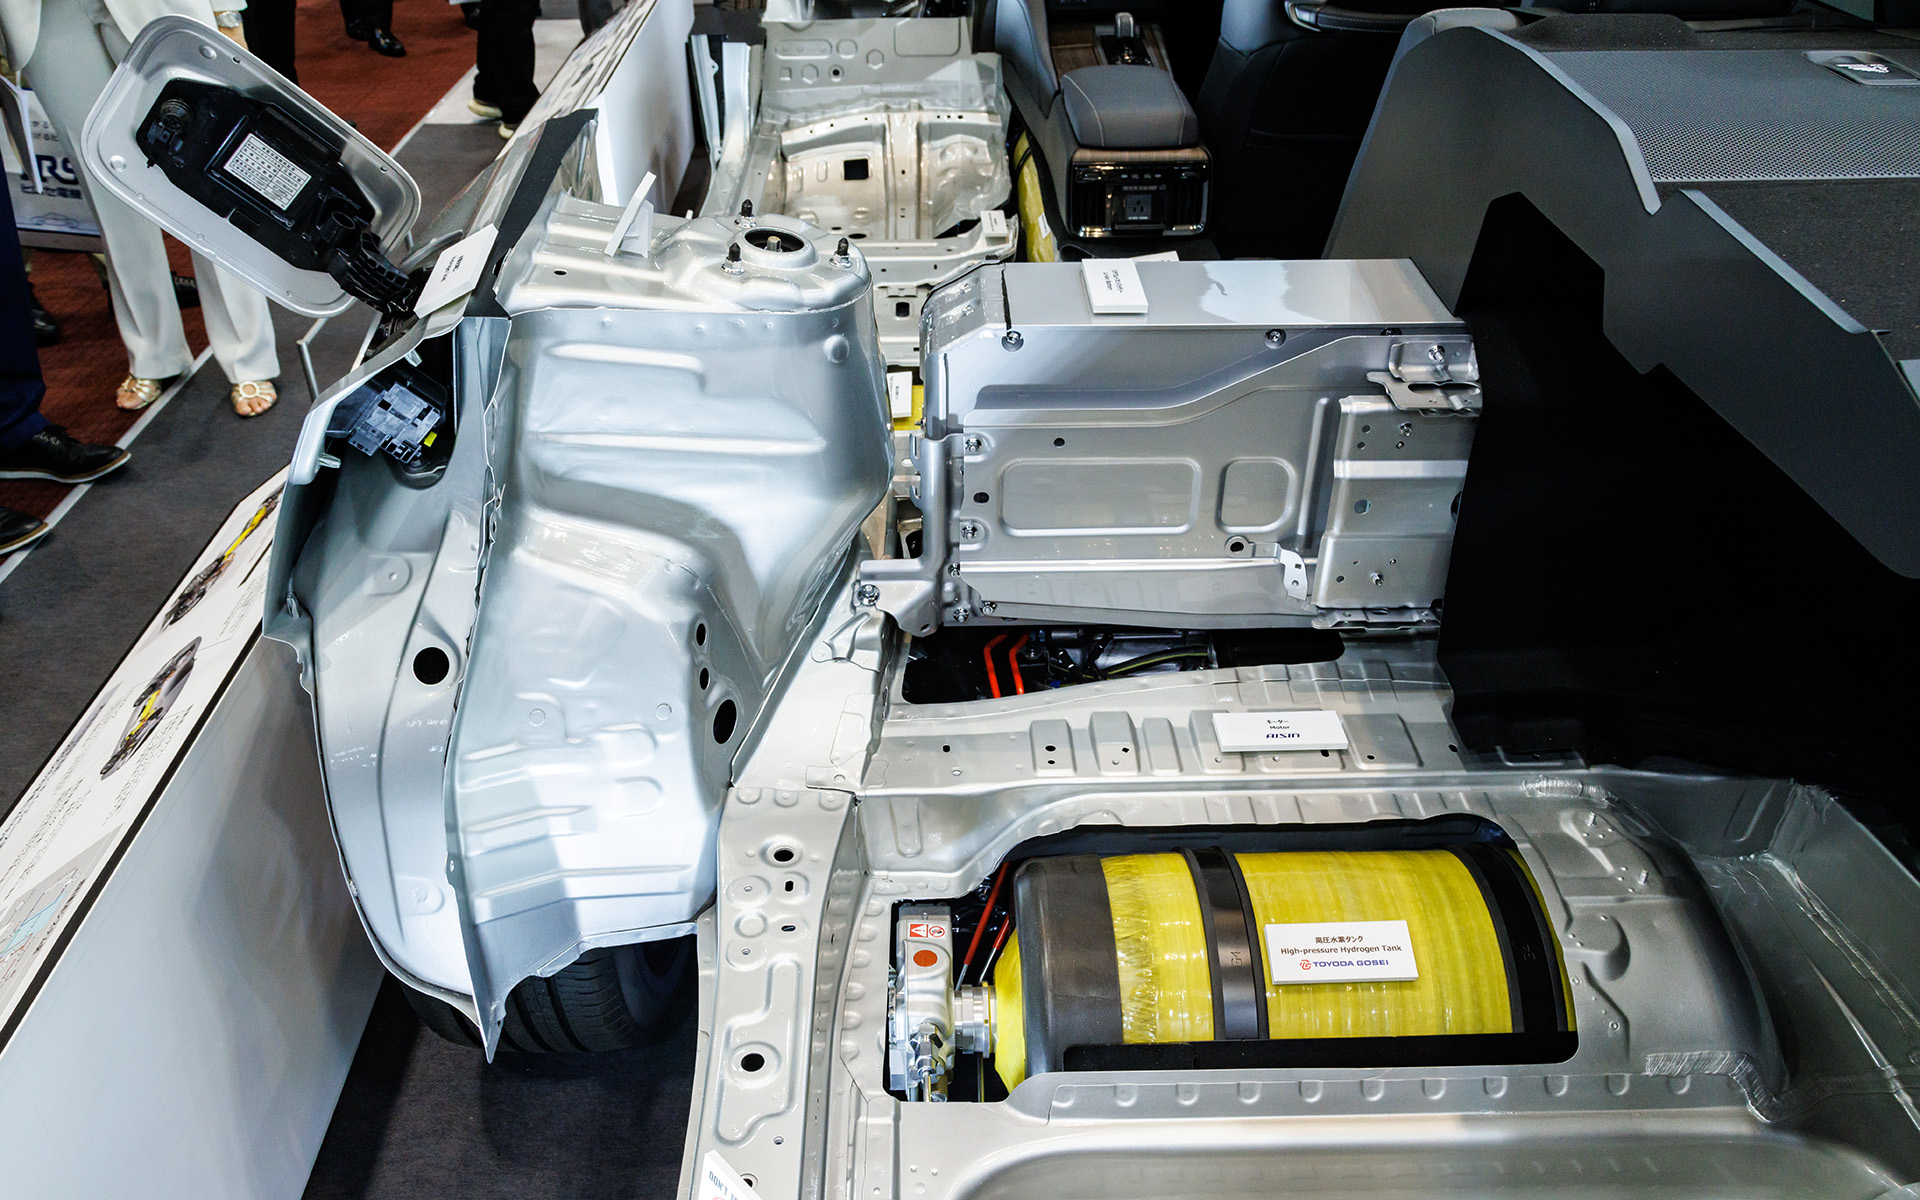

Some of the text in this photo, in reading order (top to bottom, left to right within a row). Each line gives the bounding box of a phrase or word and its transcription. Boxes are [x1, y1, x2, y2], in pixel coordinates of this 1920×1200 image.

[1315, 936, 1364, 944] 高圧水素タンク
[1281, 947, 1338, 955] High-pressure
[1340, 946, 1379, 954] Hydrogen
[709, 1171, 727, 1194] DON'T
